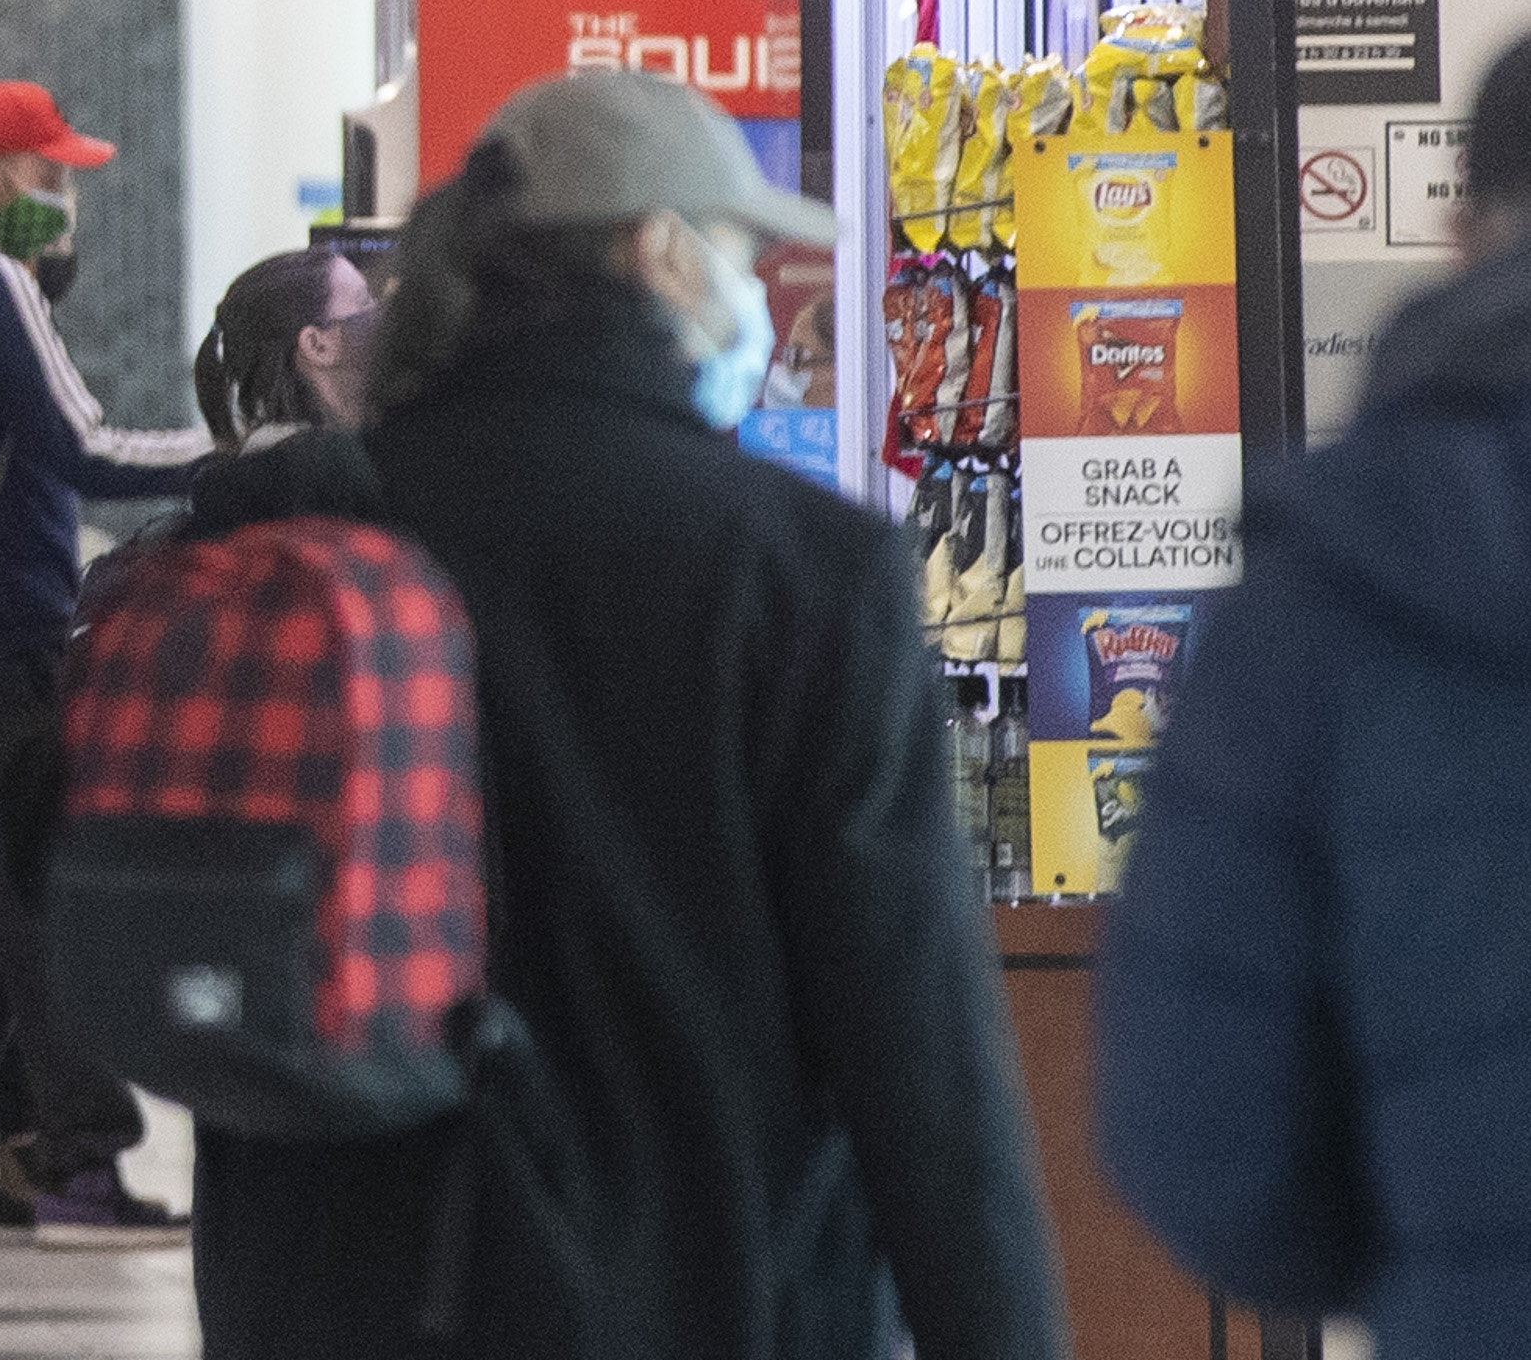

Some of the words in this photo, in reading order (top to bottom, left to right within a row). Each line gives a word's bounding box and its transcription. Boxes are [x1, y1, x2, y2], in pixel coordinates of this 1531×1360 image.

[568, 11, 638, 36] THE
[1089, 342, 1165, 366] Doritos
[1082, 458, 1157, 481] GRAB
[1163, 457, 1182, 479] A
[1085, 483, 1181, 506] SNACK
[1040, 518, 1228, 544] OFFREZ-VOUS
[1036, 557, 1068, 571] UNE
[1074, 545, 1234, 570] COLLATION
